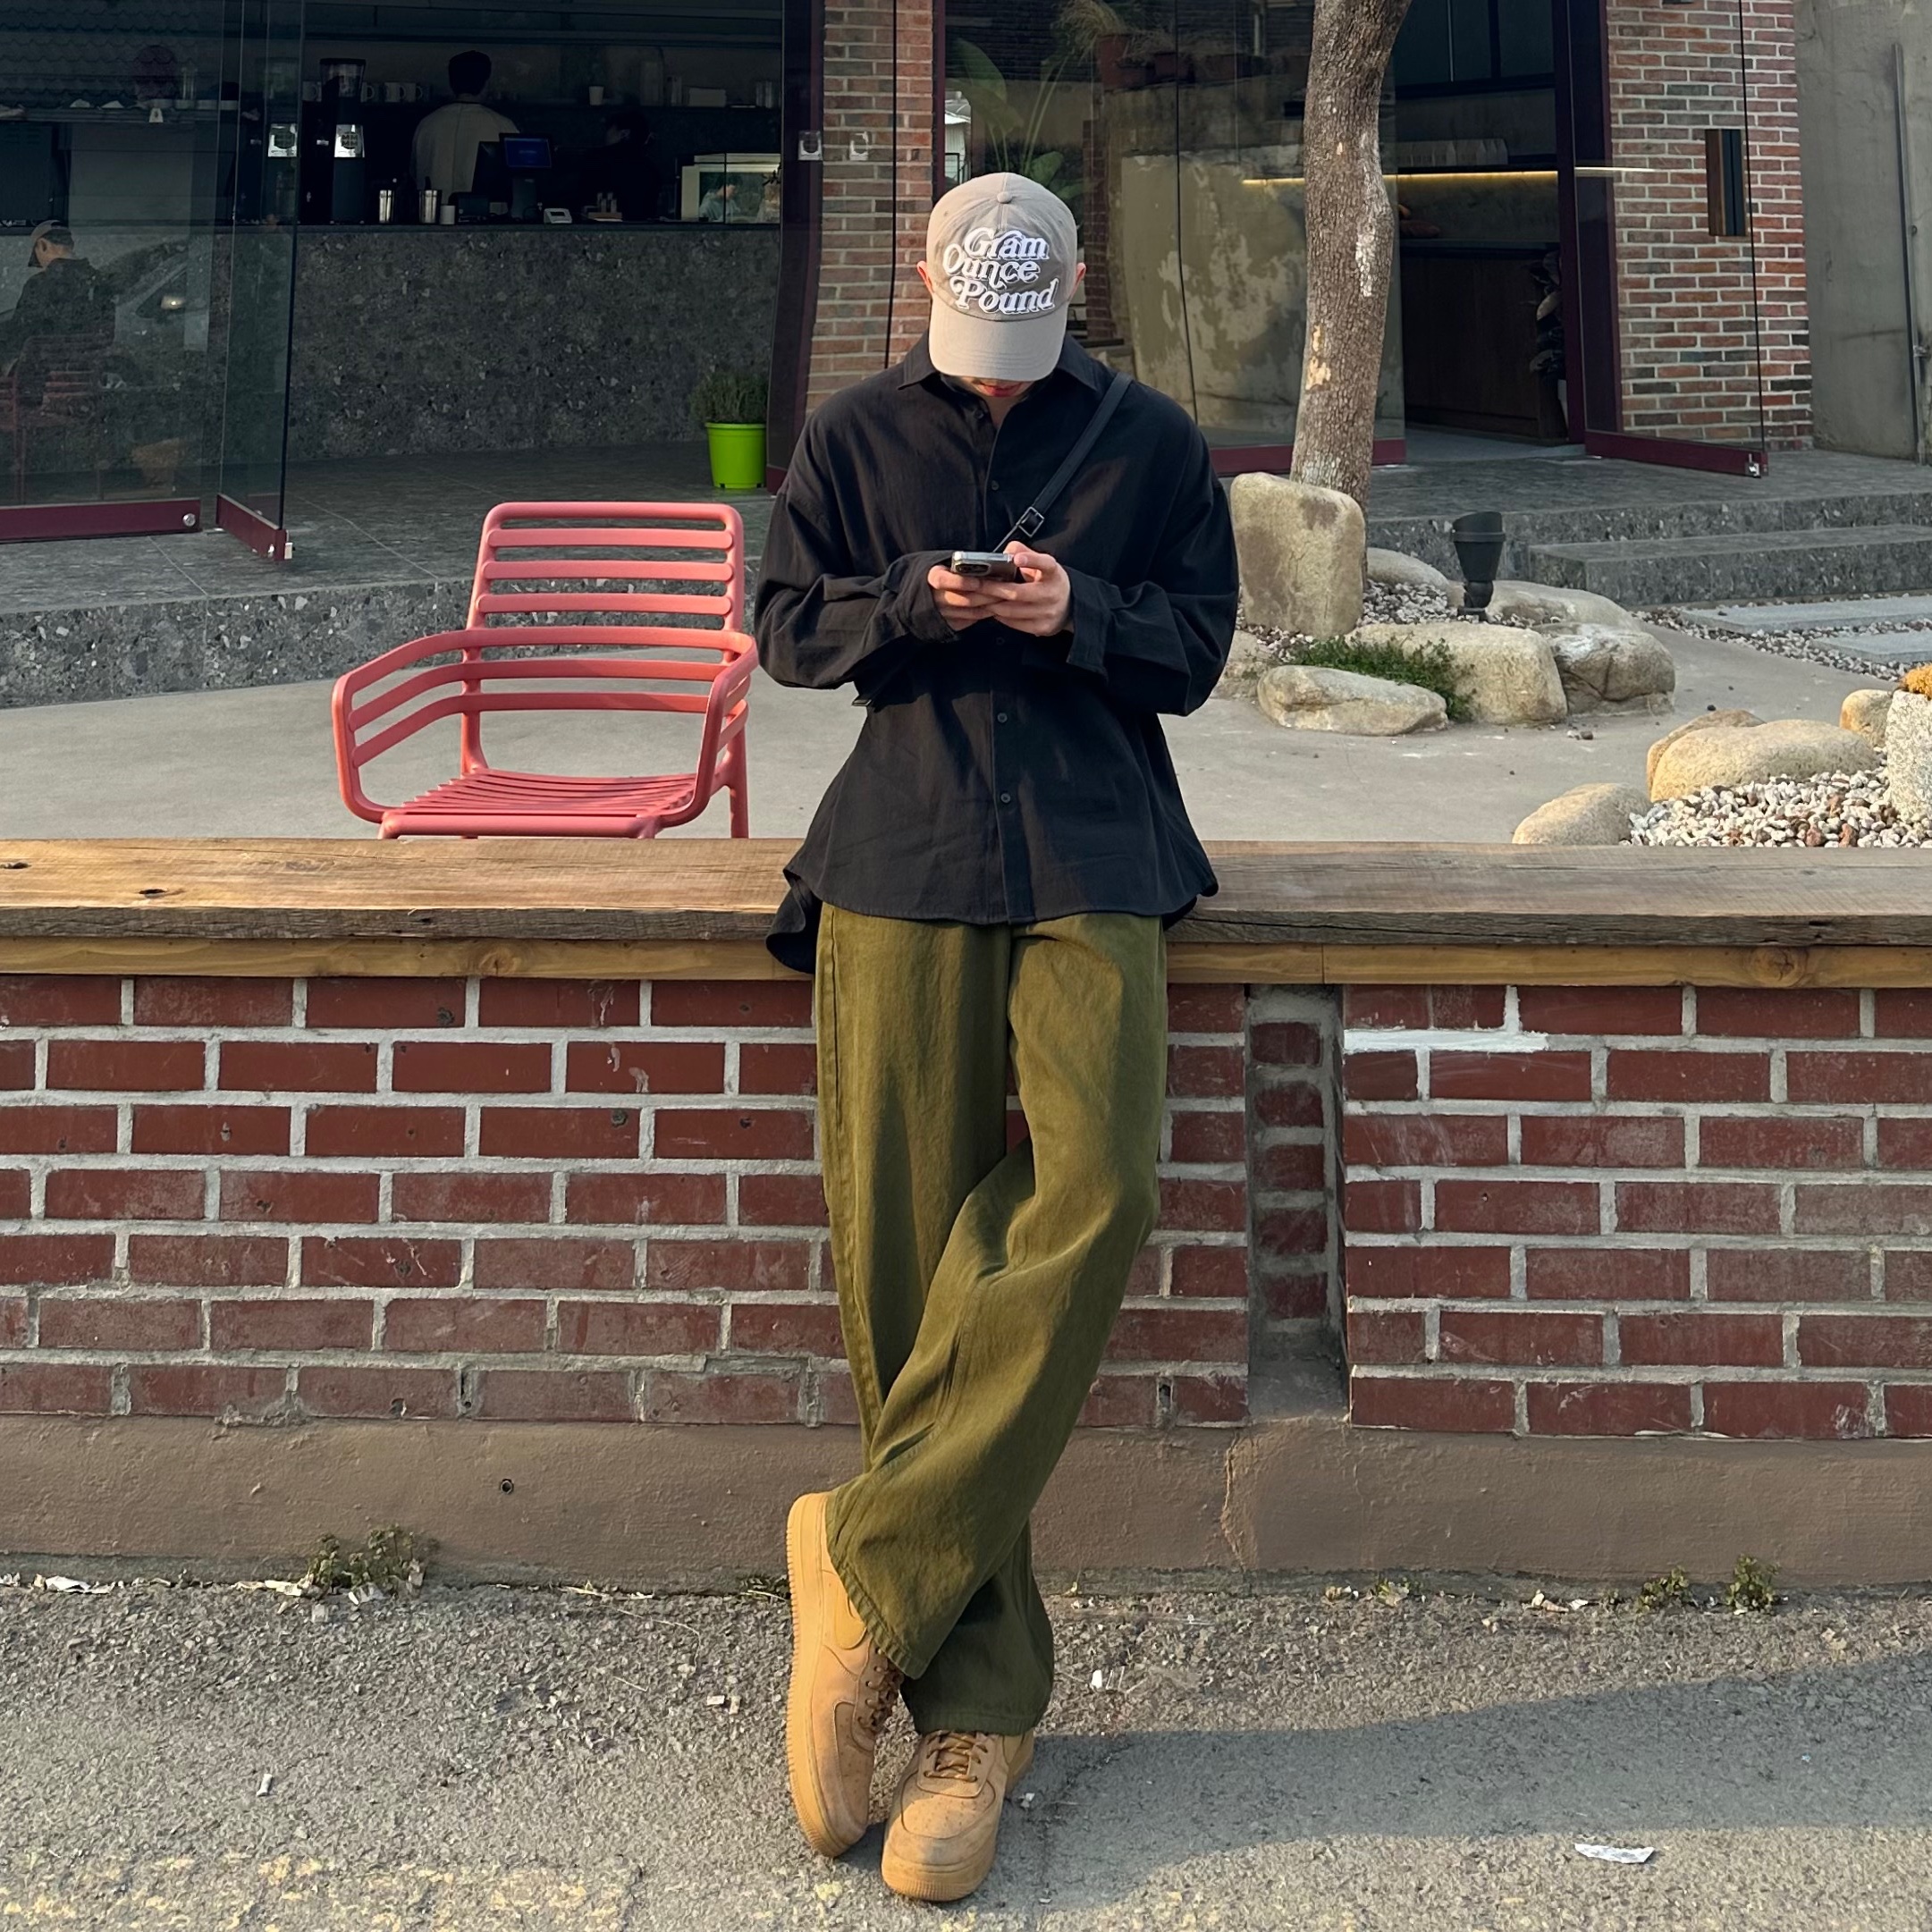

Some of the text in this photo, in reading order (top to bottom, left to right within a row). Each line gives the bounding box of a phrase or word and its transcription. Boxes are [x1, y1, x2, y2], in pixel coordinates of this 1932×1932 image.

[964, 226, 1050, 260] Gram
[942, 243, 1041, 291] Ounce
[949, 275, 1059, 315] Pound
